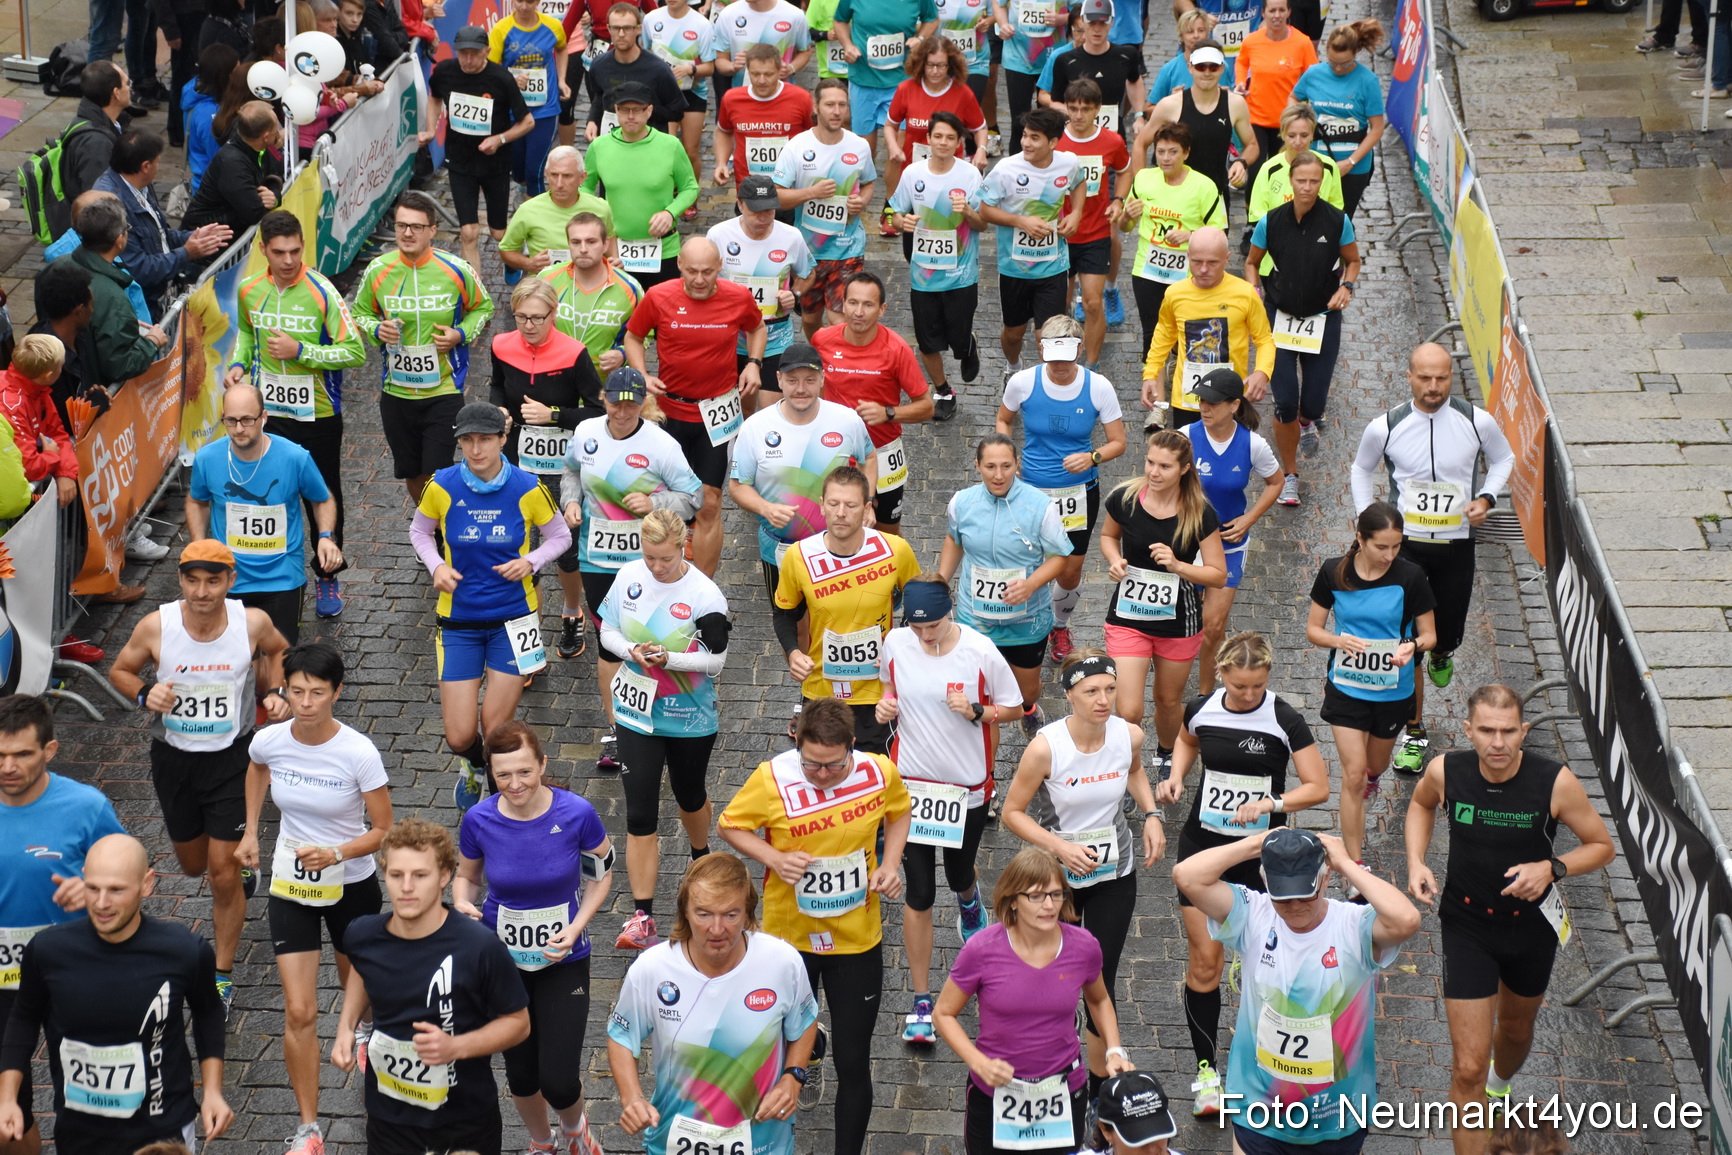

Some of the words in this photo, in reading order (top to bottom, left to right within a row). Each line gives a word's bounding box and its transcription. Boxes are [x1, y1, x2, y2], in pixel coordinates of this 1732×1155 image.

[1023, 11, 1045, 24] 255
[1222, 31, 1244, 45] 194
[831, 50, 844, 61] 26
[871, 42, 902, 57] 3066
[522, 79, 545, 92] 58
[453, 103, 488, 122] 2279
[462, 122, 476, 130] Hans
[737, 123, 782, 131] NEUMARKT
[909, 118, 928, 126] NEUM
[751, 148, 783, 162] 260
[807, 201, 844, 221] 3059
[1150, 206, 1182, 219] Müller
[917, 238, 953, 254] 2735
[1018, 231, 1055, 247] 2820
[620, 244, 657, 259] 2617
[1021, 249, 1035, 257] Amir
[1036, 249, 1050, 257] Reza
[1150, 250, 1186, 270] 2528
[384, 294, 452, 312] BOCK
[251, 311, 317, 332] BOCK
[1286, 316, 1315, 336] 174
[394, 354, 434, 372] 2835
[265, 384, 309, 404] 2869
[708, 397, 740, 427] 2313
[524, 437, 567, 456] 2600
[536, 460, 555, 468] Petra
[1055, 498, 1077, 516] 19
[1416, 493, 1455, 513] 317
[239, 516, 276, 536] 150
[1419, 516, 1448, 526] Thomas
[492, 525, 506, 536] FR
[236, 539, 277, 549] Alexander
[594, 531, 640, 551] 2750
[607, 553, 626, 562] Karin
[814, 578, 852, 599] MAX
[856, 563, 897, 586] BÖGL
[976, 580, 1008, 600] 273
[1124, 580, 1172, 606] 2733
[983, 603, 1013, 612] Melanie
[1130, 599, 1161, 616] Melanie
[517, 628, 541, 653] 22
[828, 640, 879, 663] 3053
[191, 664, 233, 672] KLEBL
[1342, 652, 1394, 672] 2009
[1343, 671, 1387, 685] CAROLIN
[613, 676, 648, 712] 2430
[171, 696, 228, 718] 2315
[181, 723, 214, 733] Roland
[304, 777, 343, 789] NEUMARKT
[1081, 771, 1122, 784] KLEBL
[1208, 786, 1265, 812] 2227
[790, 815, 836, 838] MAX
[841, 796, 884, 824] BÖGL
[911, 796, 961, 824] 2800
[1477, 809, 1534, 821] rettenmeier
[915, 825, 945, 838] Marina
[803, 867, 860, 894] 2811
[289, 886, 323, 898] Brigitte
[810, 896, 855, 910] Christoph
[529, 908, 563, 920] BOCK
[0, 944, 25, 966] 33
[521, 953, 541, 963] Rita
[749, 994, 774, 1005] Hervis
[659, 1008, 681, 1018] PARTL
[1286, 1018, 1324, 1030] BOCK
[439, 1000, 458, 1087] RANE
[1276, 1030, 1309, 1059] 72
[70, 1059, 136, 1090] 2577
[149, 1024, 166, 1116] RAILONE
[383, 1054, 431, 1084] 222
[1272, 1058, 1313, 1076] Thomas
[392, 1082, 428, 1100] Thomas
[86, 1094, 121, 1107] Tobias
[1001, 1094, 1064, 1123] 2435
[1018, 1128, 1046, 1139] Petra
[676, 1137, 745, 1155] 2616
